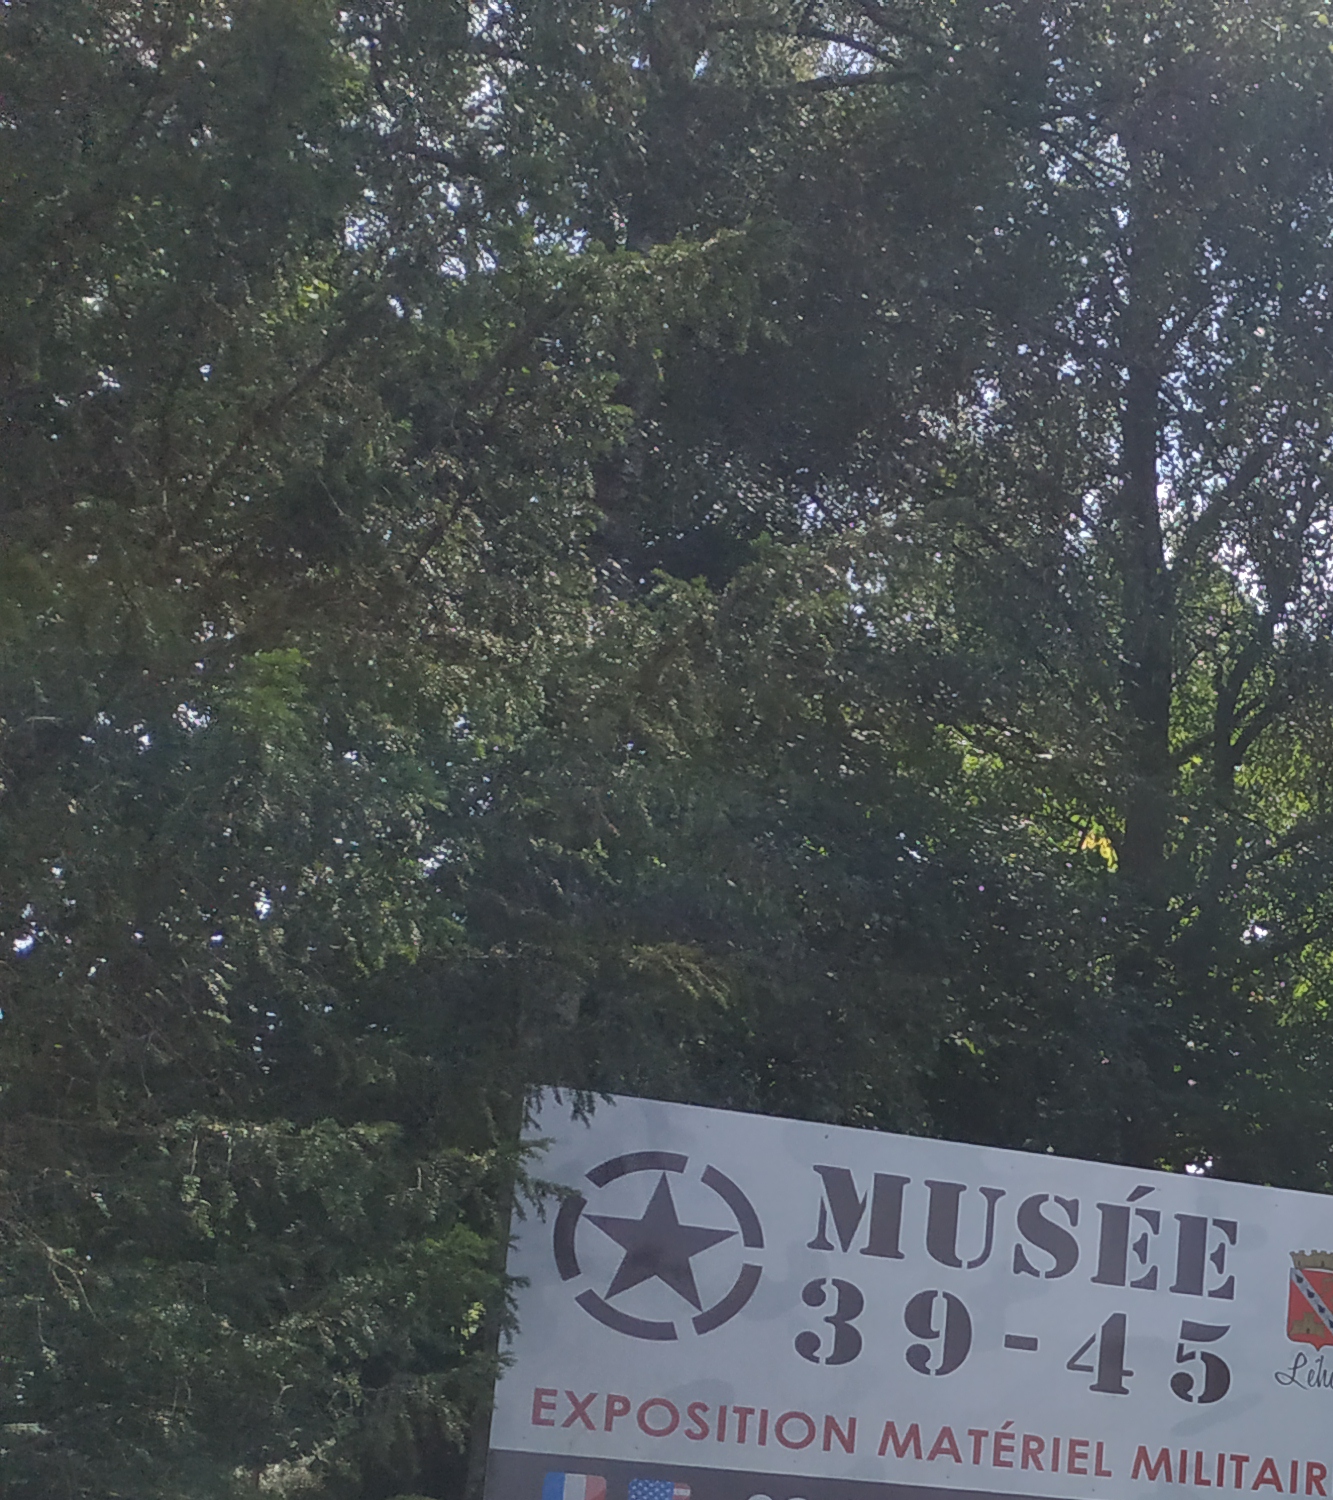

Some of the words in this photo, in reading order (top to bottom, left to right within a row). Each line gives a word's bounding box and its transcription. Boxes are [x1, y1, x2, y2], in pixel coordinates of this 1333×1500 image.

[806, 1163, 1238, 1300] MUSÉE
[531, 1386, 858, 1455] EXPOSITION
[876, 1420, 1112, 1479] MATÉRIEL
